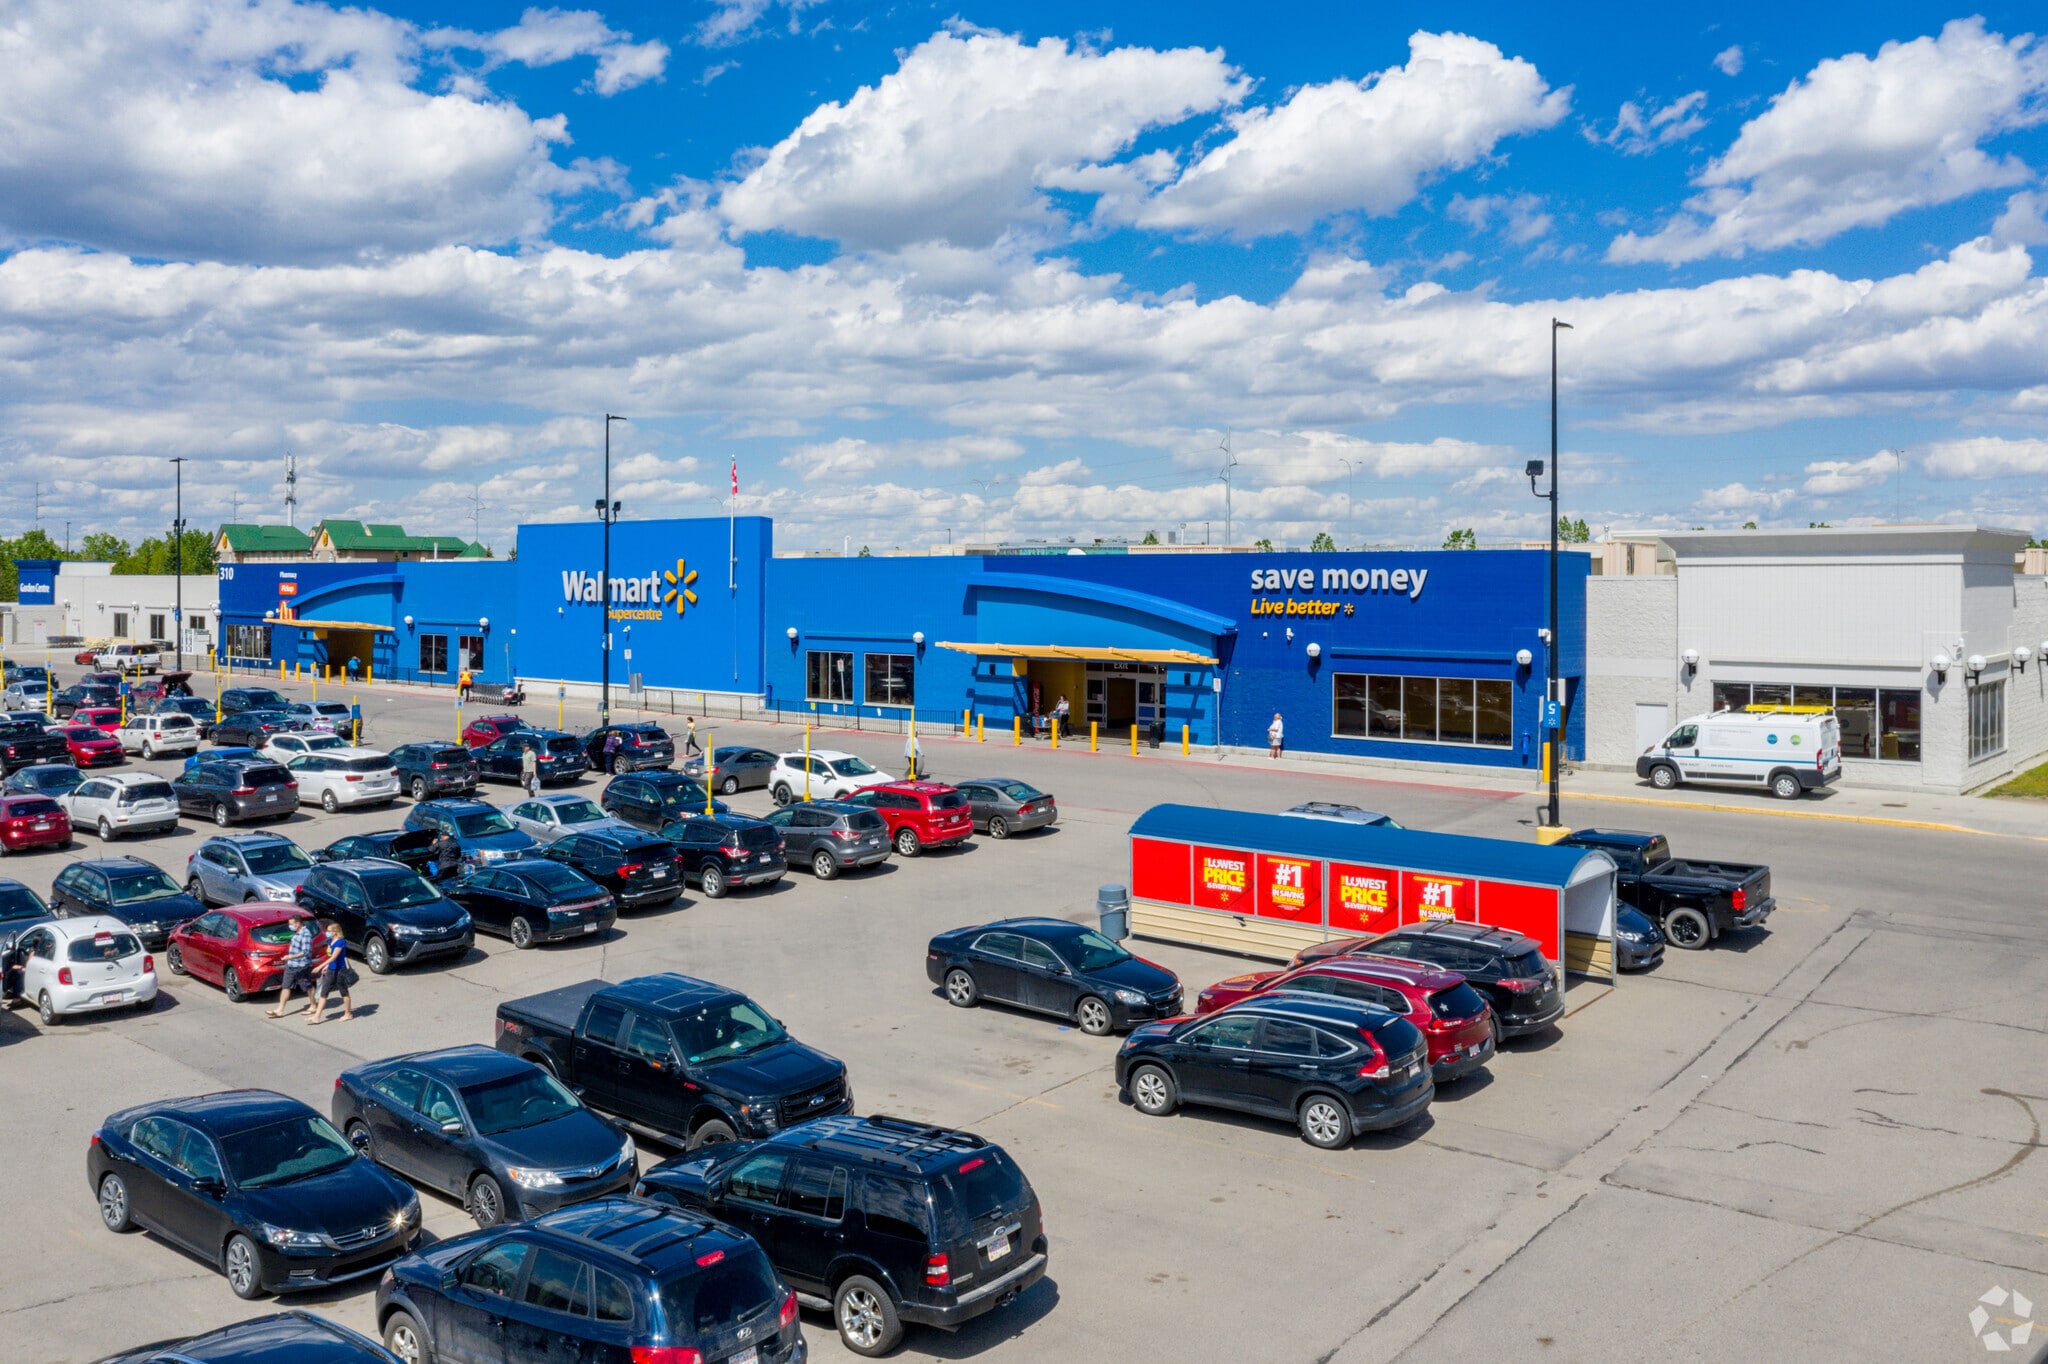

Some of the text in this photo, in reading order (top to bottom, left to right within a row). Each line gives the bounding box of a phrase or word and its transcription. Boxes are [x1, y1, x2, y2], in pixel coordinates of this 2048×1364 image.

[220, 567, 234, 580] 310
[1251, 568, 1428, 599] save money
[562, 570, 662, 603] Walmart
[1251, 598, 1340, 615] Live better
[1208, 858, 1245, 871] LOWEST
[1204, 867, 1245, 887] PRICE
[1276, 864, 1302, 887] #1
[1345, 876, 1387, 890] LOWEST
[1341, 886, 1387, 907] PRICE
[1423, 882, 1452, 907] #1
